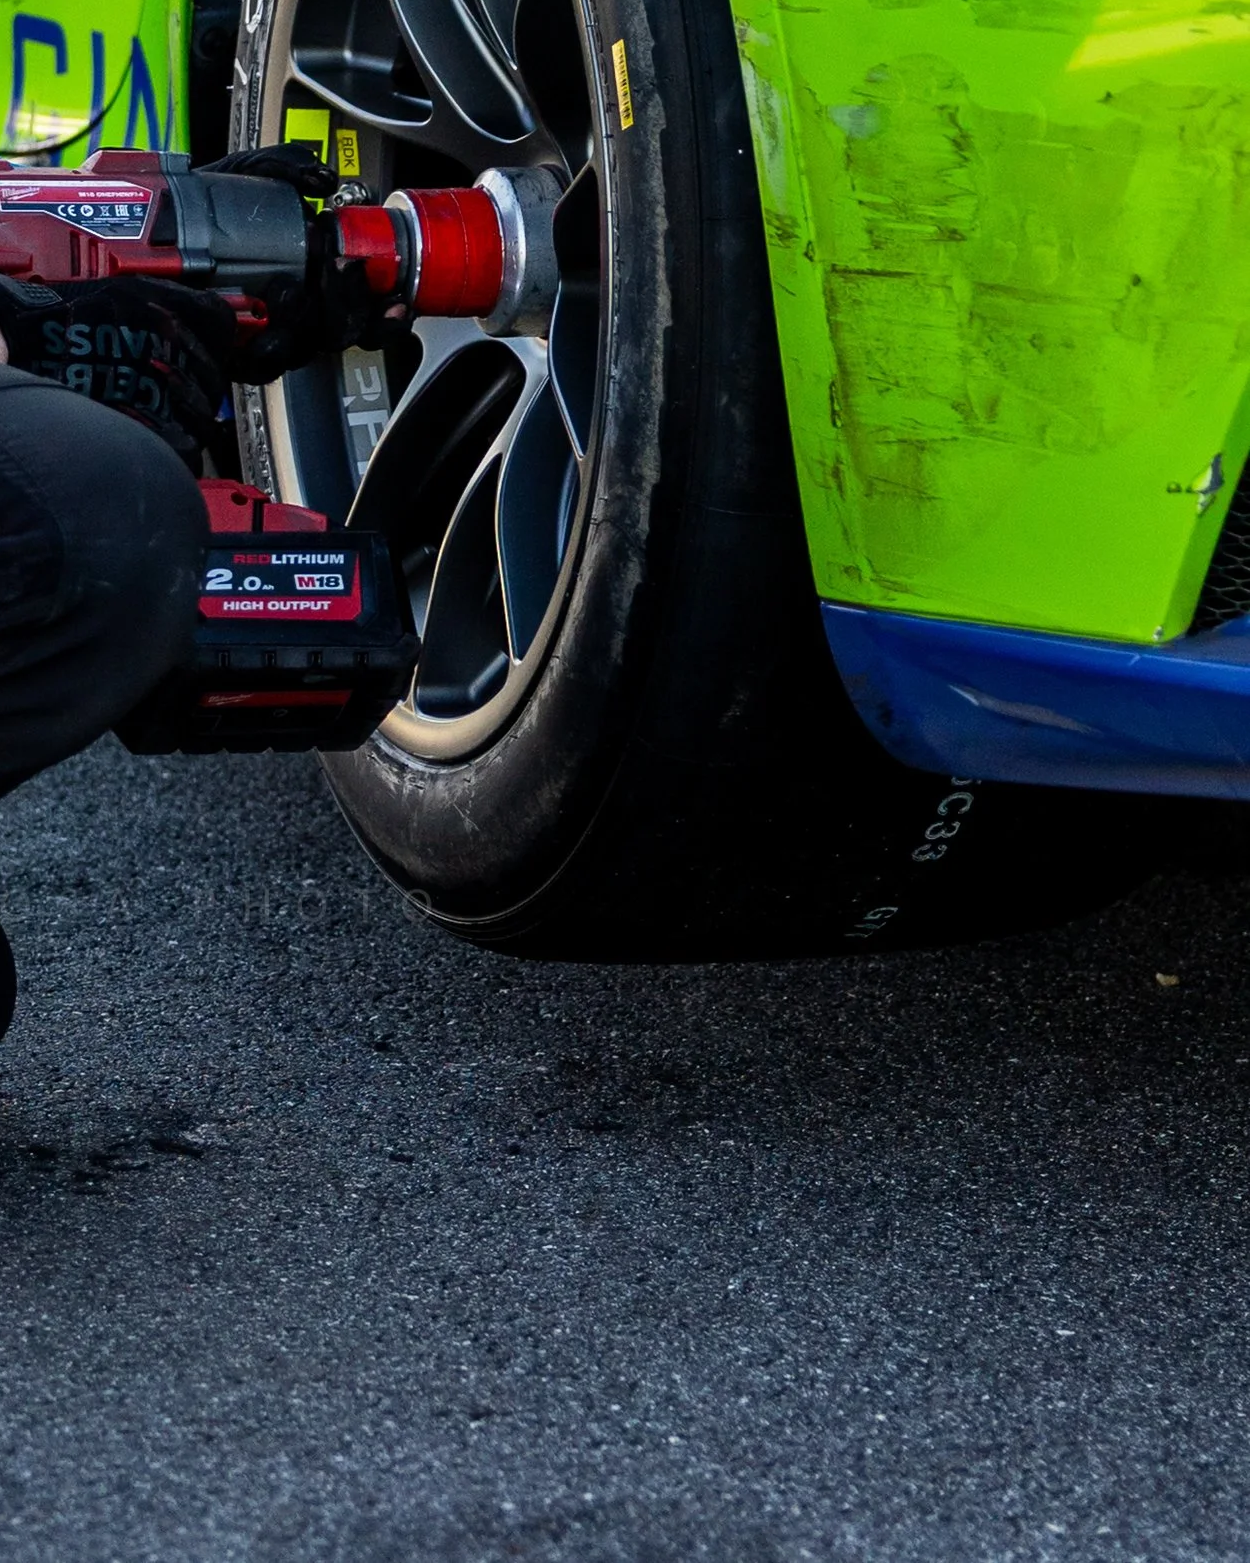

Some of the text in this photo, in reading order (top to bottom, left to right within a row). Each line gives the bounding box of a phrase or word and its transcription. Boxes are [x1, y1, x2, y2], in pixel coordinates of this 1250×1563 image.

[341, 136, 356, 168] RDK
[233, 553, 345, 565] REDLITHIUM
[295, 575, 343, 589] M18
[223, 600, 332, 611] HIGH OUTPUT
[911, 776, 982, 862] C33
